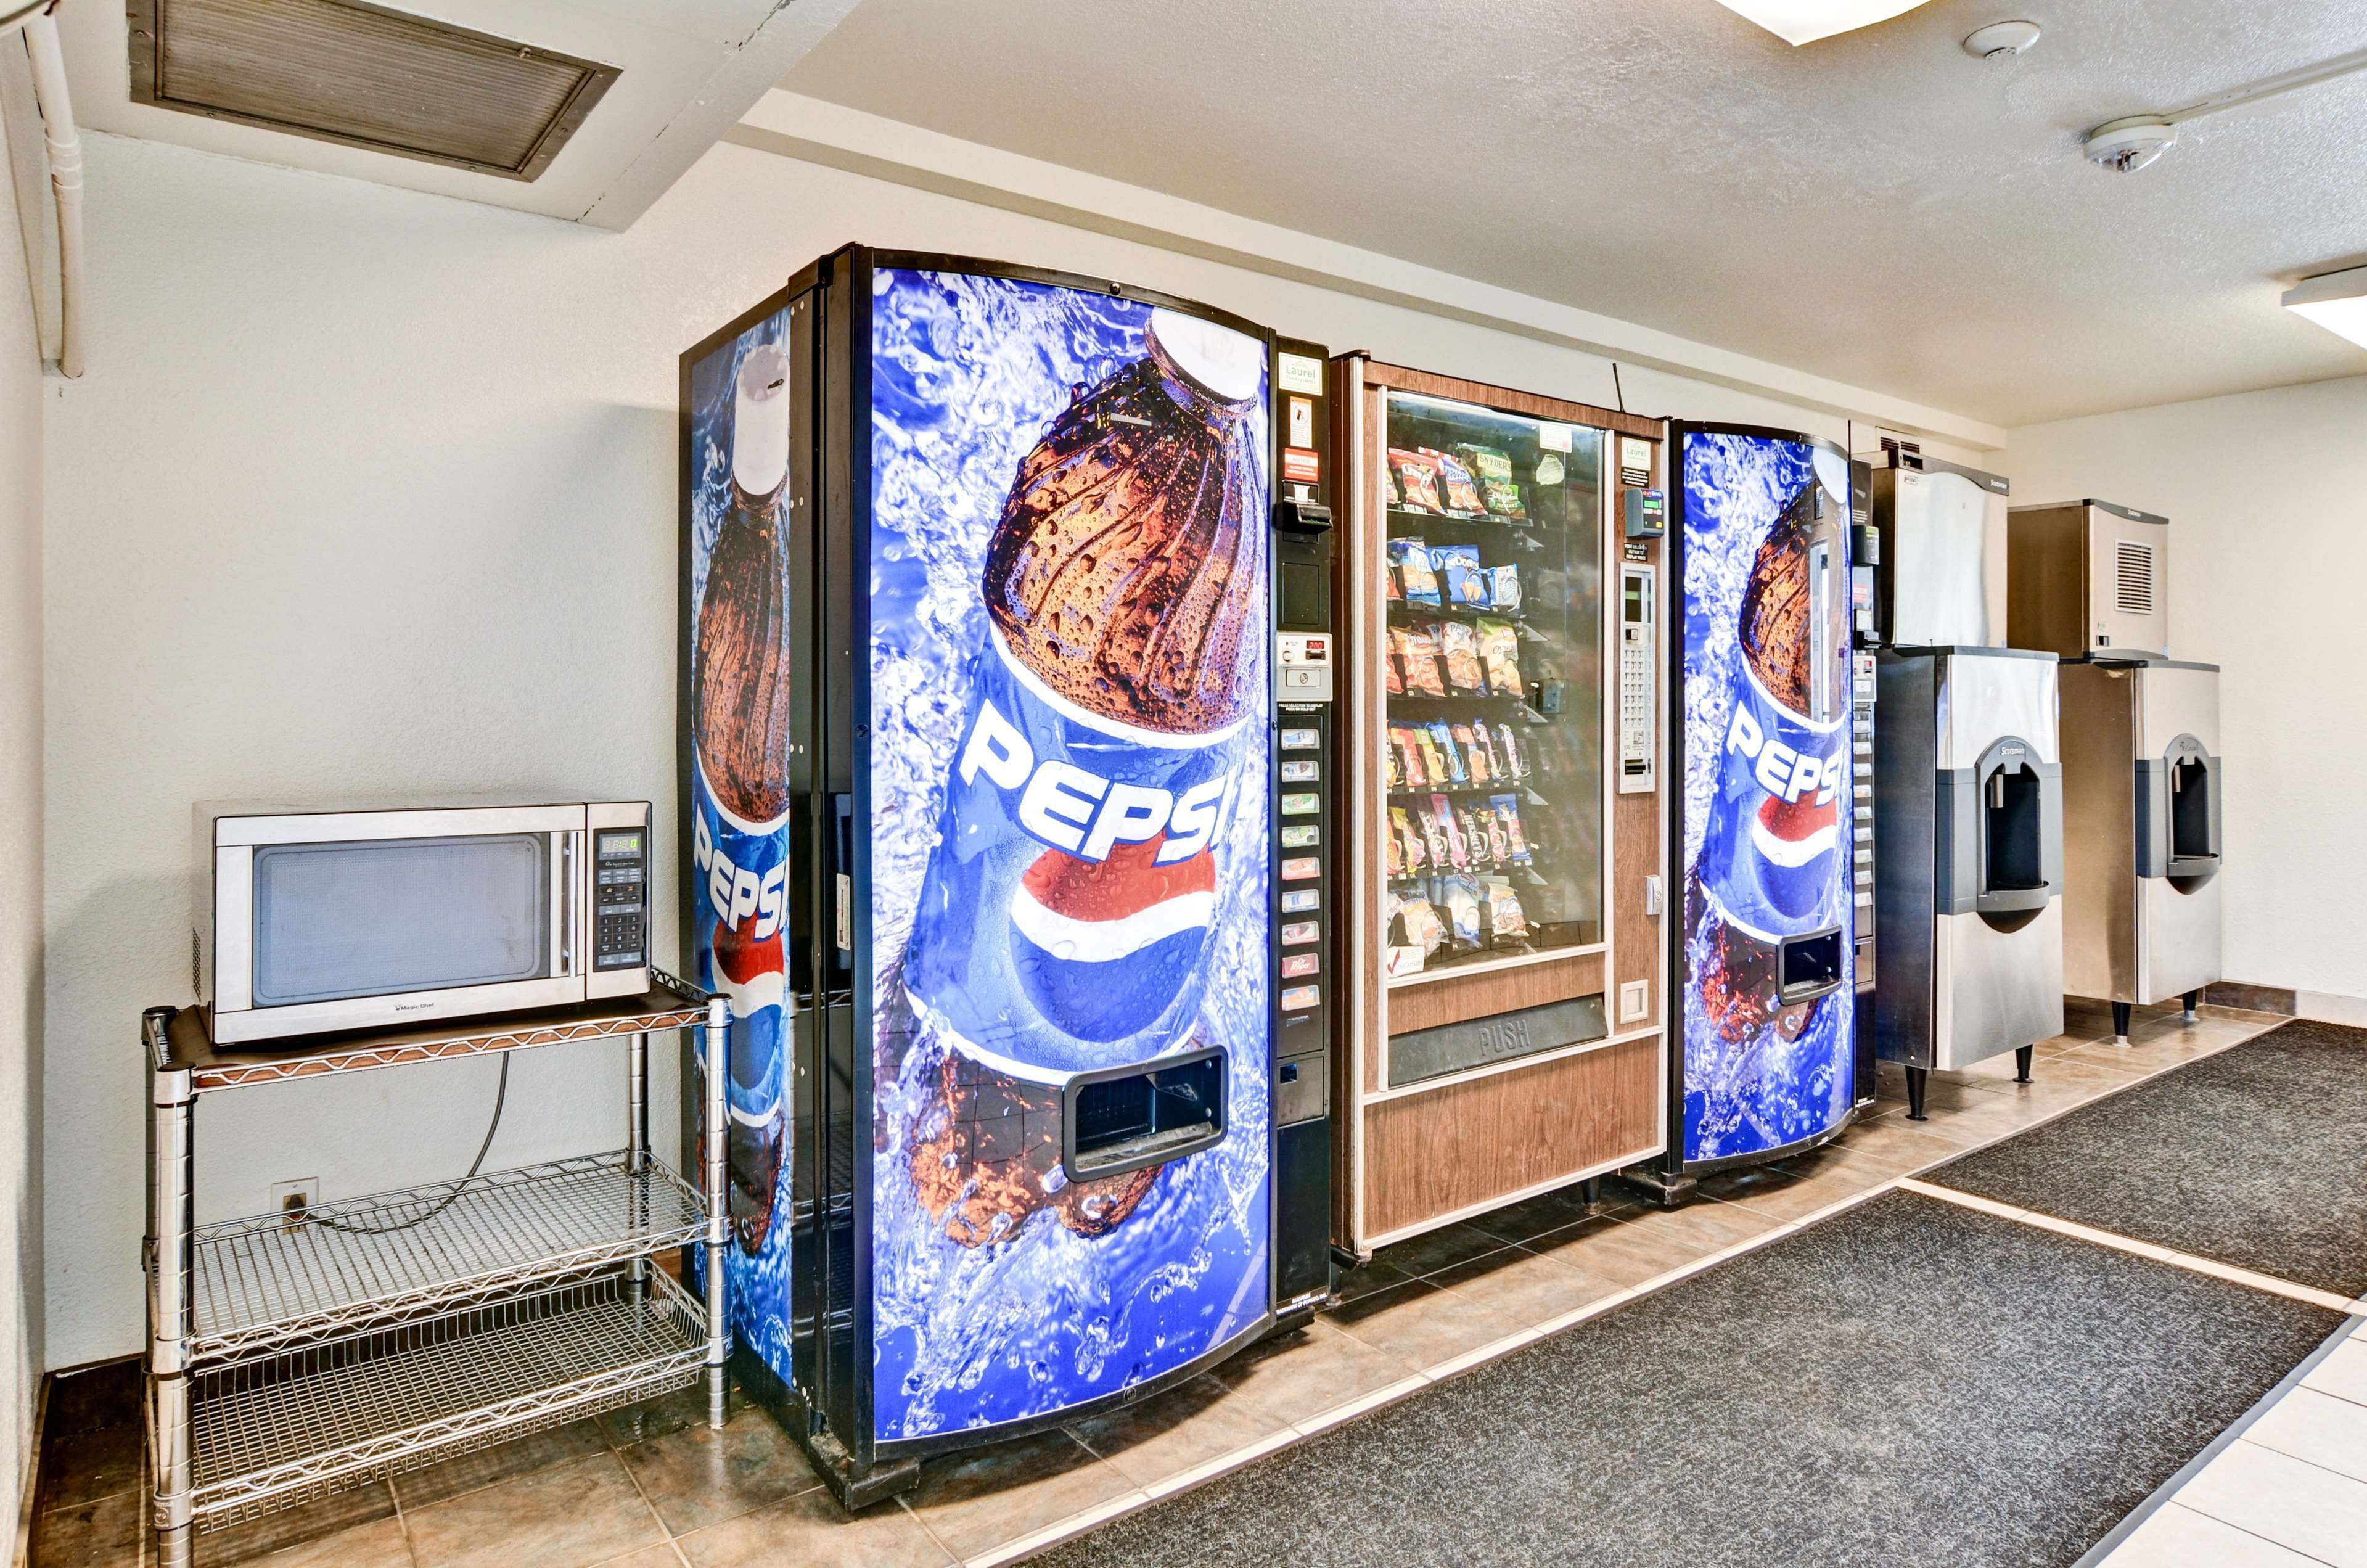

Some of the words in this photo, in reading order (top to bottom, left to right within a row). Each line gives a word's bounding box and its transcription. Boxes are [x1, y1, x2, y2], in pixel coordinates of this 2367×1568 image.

[1286, 364, 1315, 380] Laurel
[1627, 446, 1647, 457] Laurel
[1480, 455, 1512, 471] SNYDER'S
[2001, 747, 2025, 755] Scotsman
[959, 697, 1239, 863] PEPSI
[694, 803, 789, 938] PEPSI
[1479, 1019, 1530, 1056] PUSH
